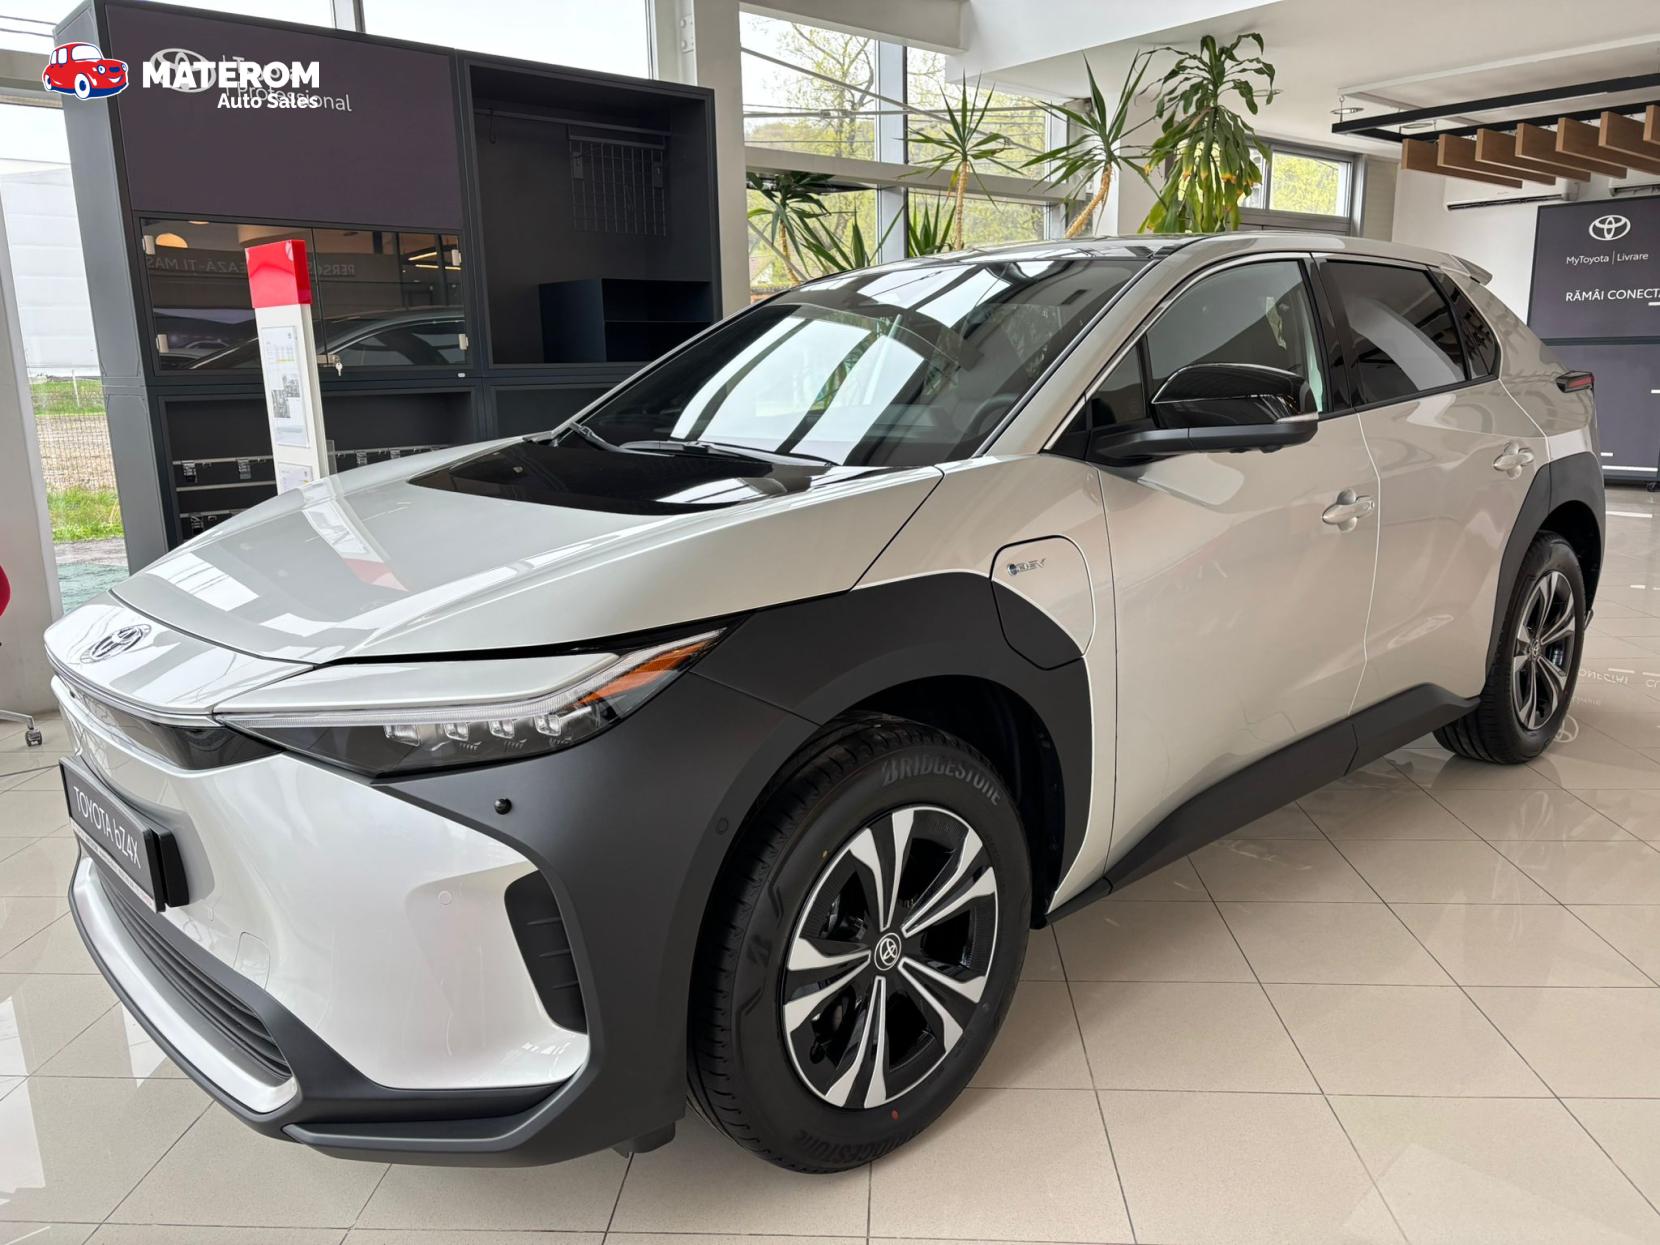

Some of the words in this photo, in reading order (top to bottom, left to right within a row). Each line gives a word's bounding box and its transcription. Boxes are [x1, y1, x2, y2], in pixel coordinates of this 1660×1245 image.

[1566, 255, 1610, 265] MyToyota
[1617, 252, 1649, 262] Livrare
[1565, 288, 1605, 302] RĂMÂI
[1607, 287, 1660, 300] CONECT
[73, 786, 114, 842] TOYOTA
[113, 818, 141, 869] bZ4X
